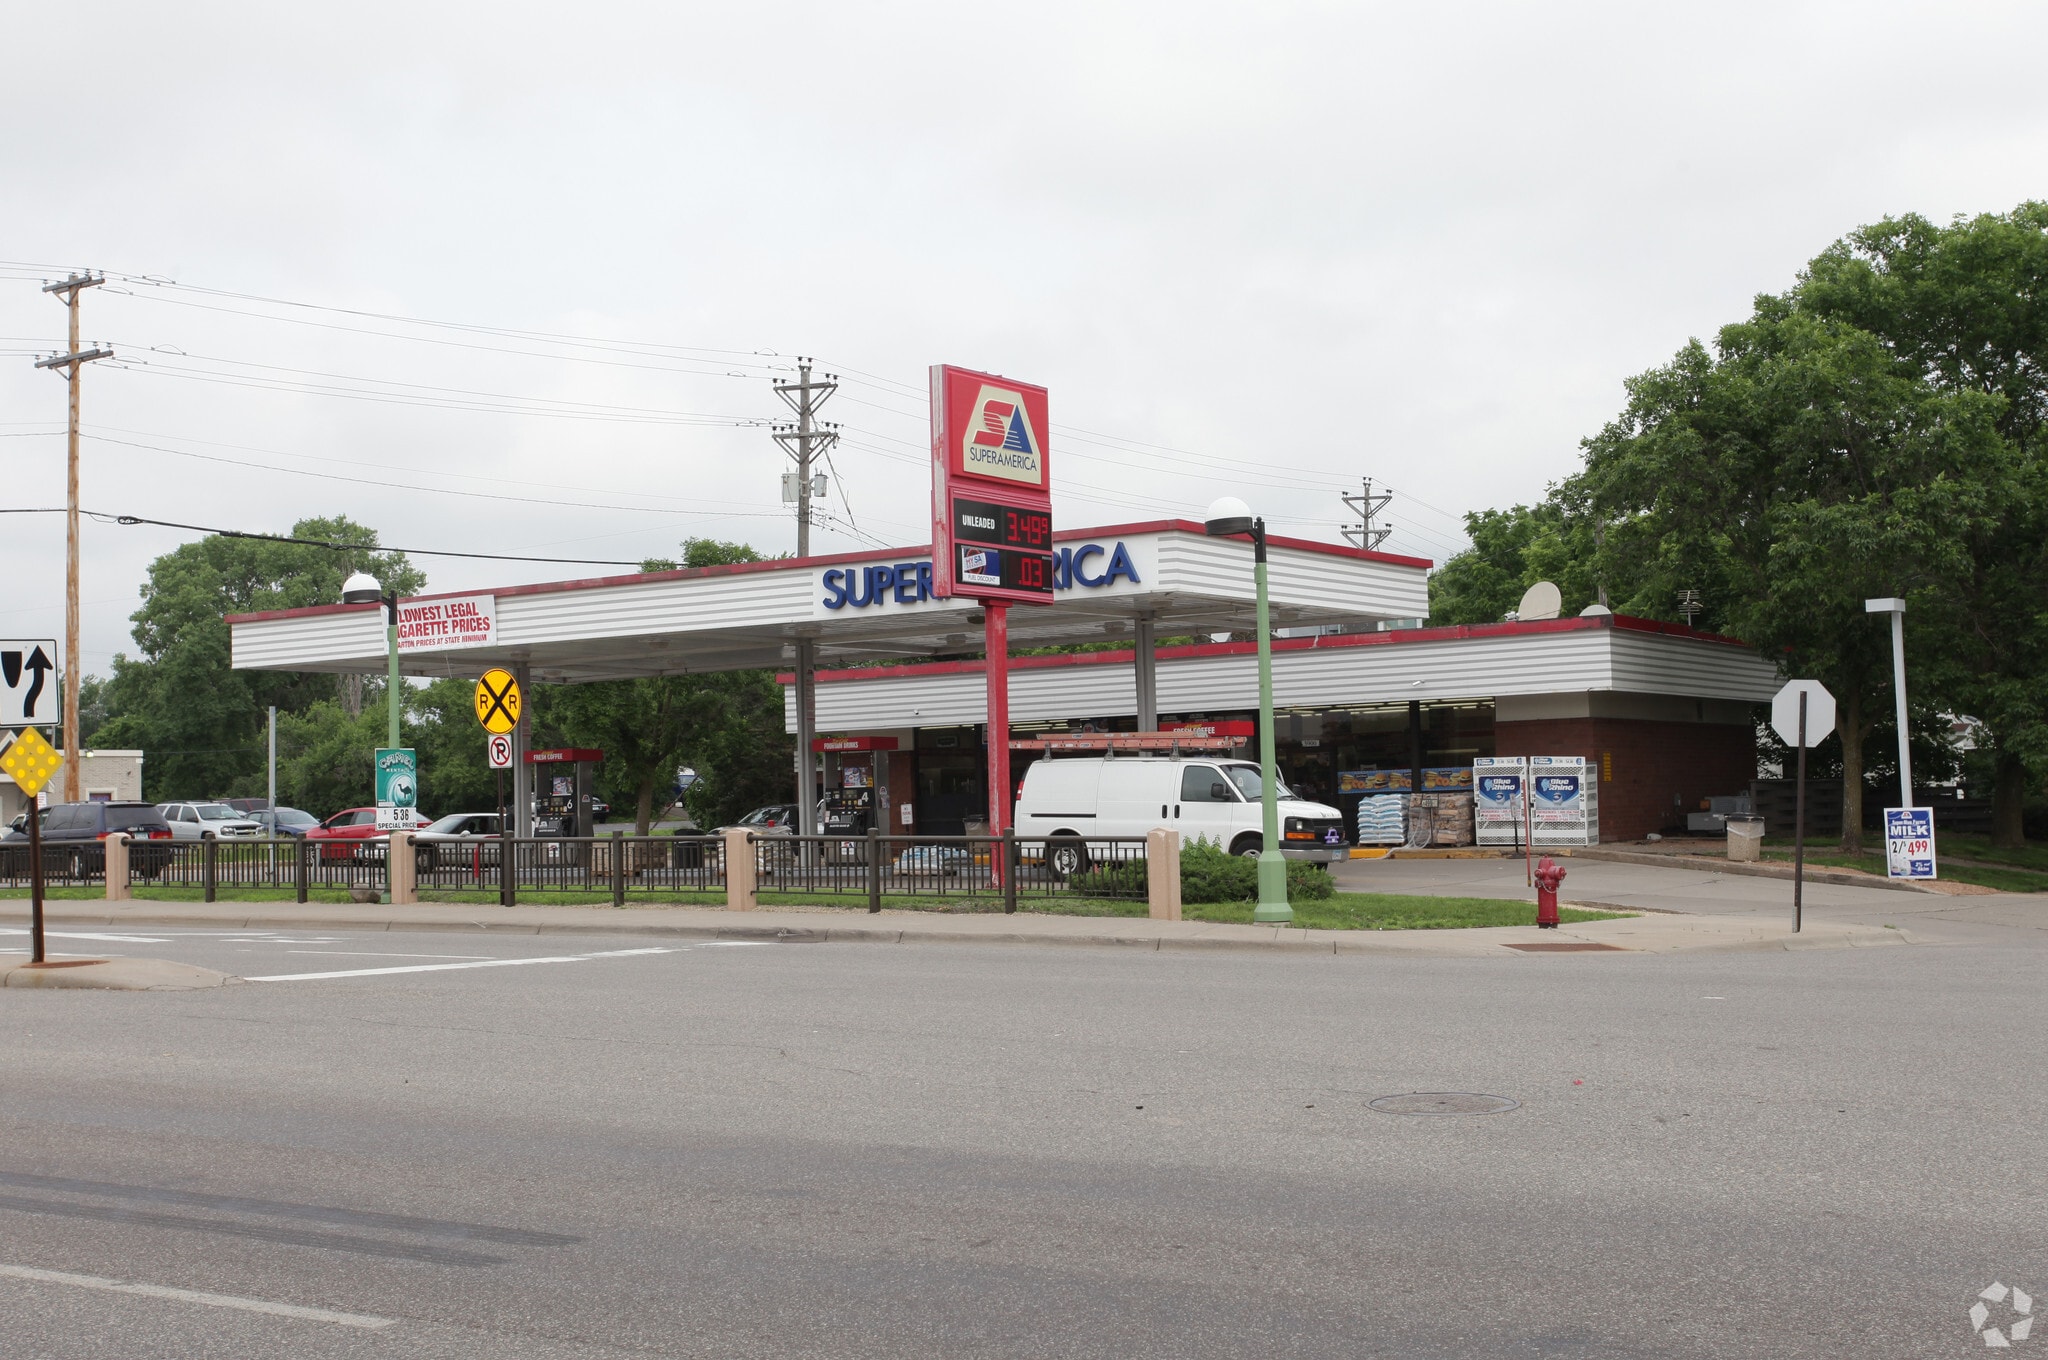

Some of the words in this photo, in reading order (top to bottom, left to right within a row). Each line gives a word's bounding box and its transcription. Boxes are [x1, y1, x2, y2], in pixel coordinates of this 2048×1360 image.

[969, 446, 1037, 471] SUPERAMERICA
[962, 514, 995, 530] UNLEADED
[977, 575, 996, 583] DISCOUNT
[397, 605, 441, 623] LOWEST
[444, 602, 479, 619] LEGAL
[397, 620, 449, 638] IGARETTE
[451, 616, 491, 634] PRICES
[397, 639, 415, 648] ARTON
[416, 638, 436, 647] PRICES
[437, 637, 443, 645] AT
[445, 635, 460, 644] STATE
[378, 751, 414, 771] CAMEL
[861, 792, 869, 802] 4
[567, 800, 573, 809] 6
[402, 821, 417, 829] PRICE
[1890, 824, 1929, 836] MILK
